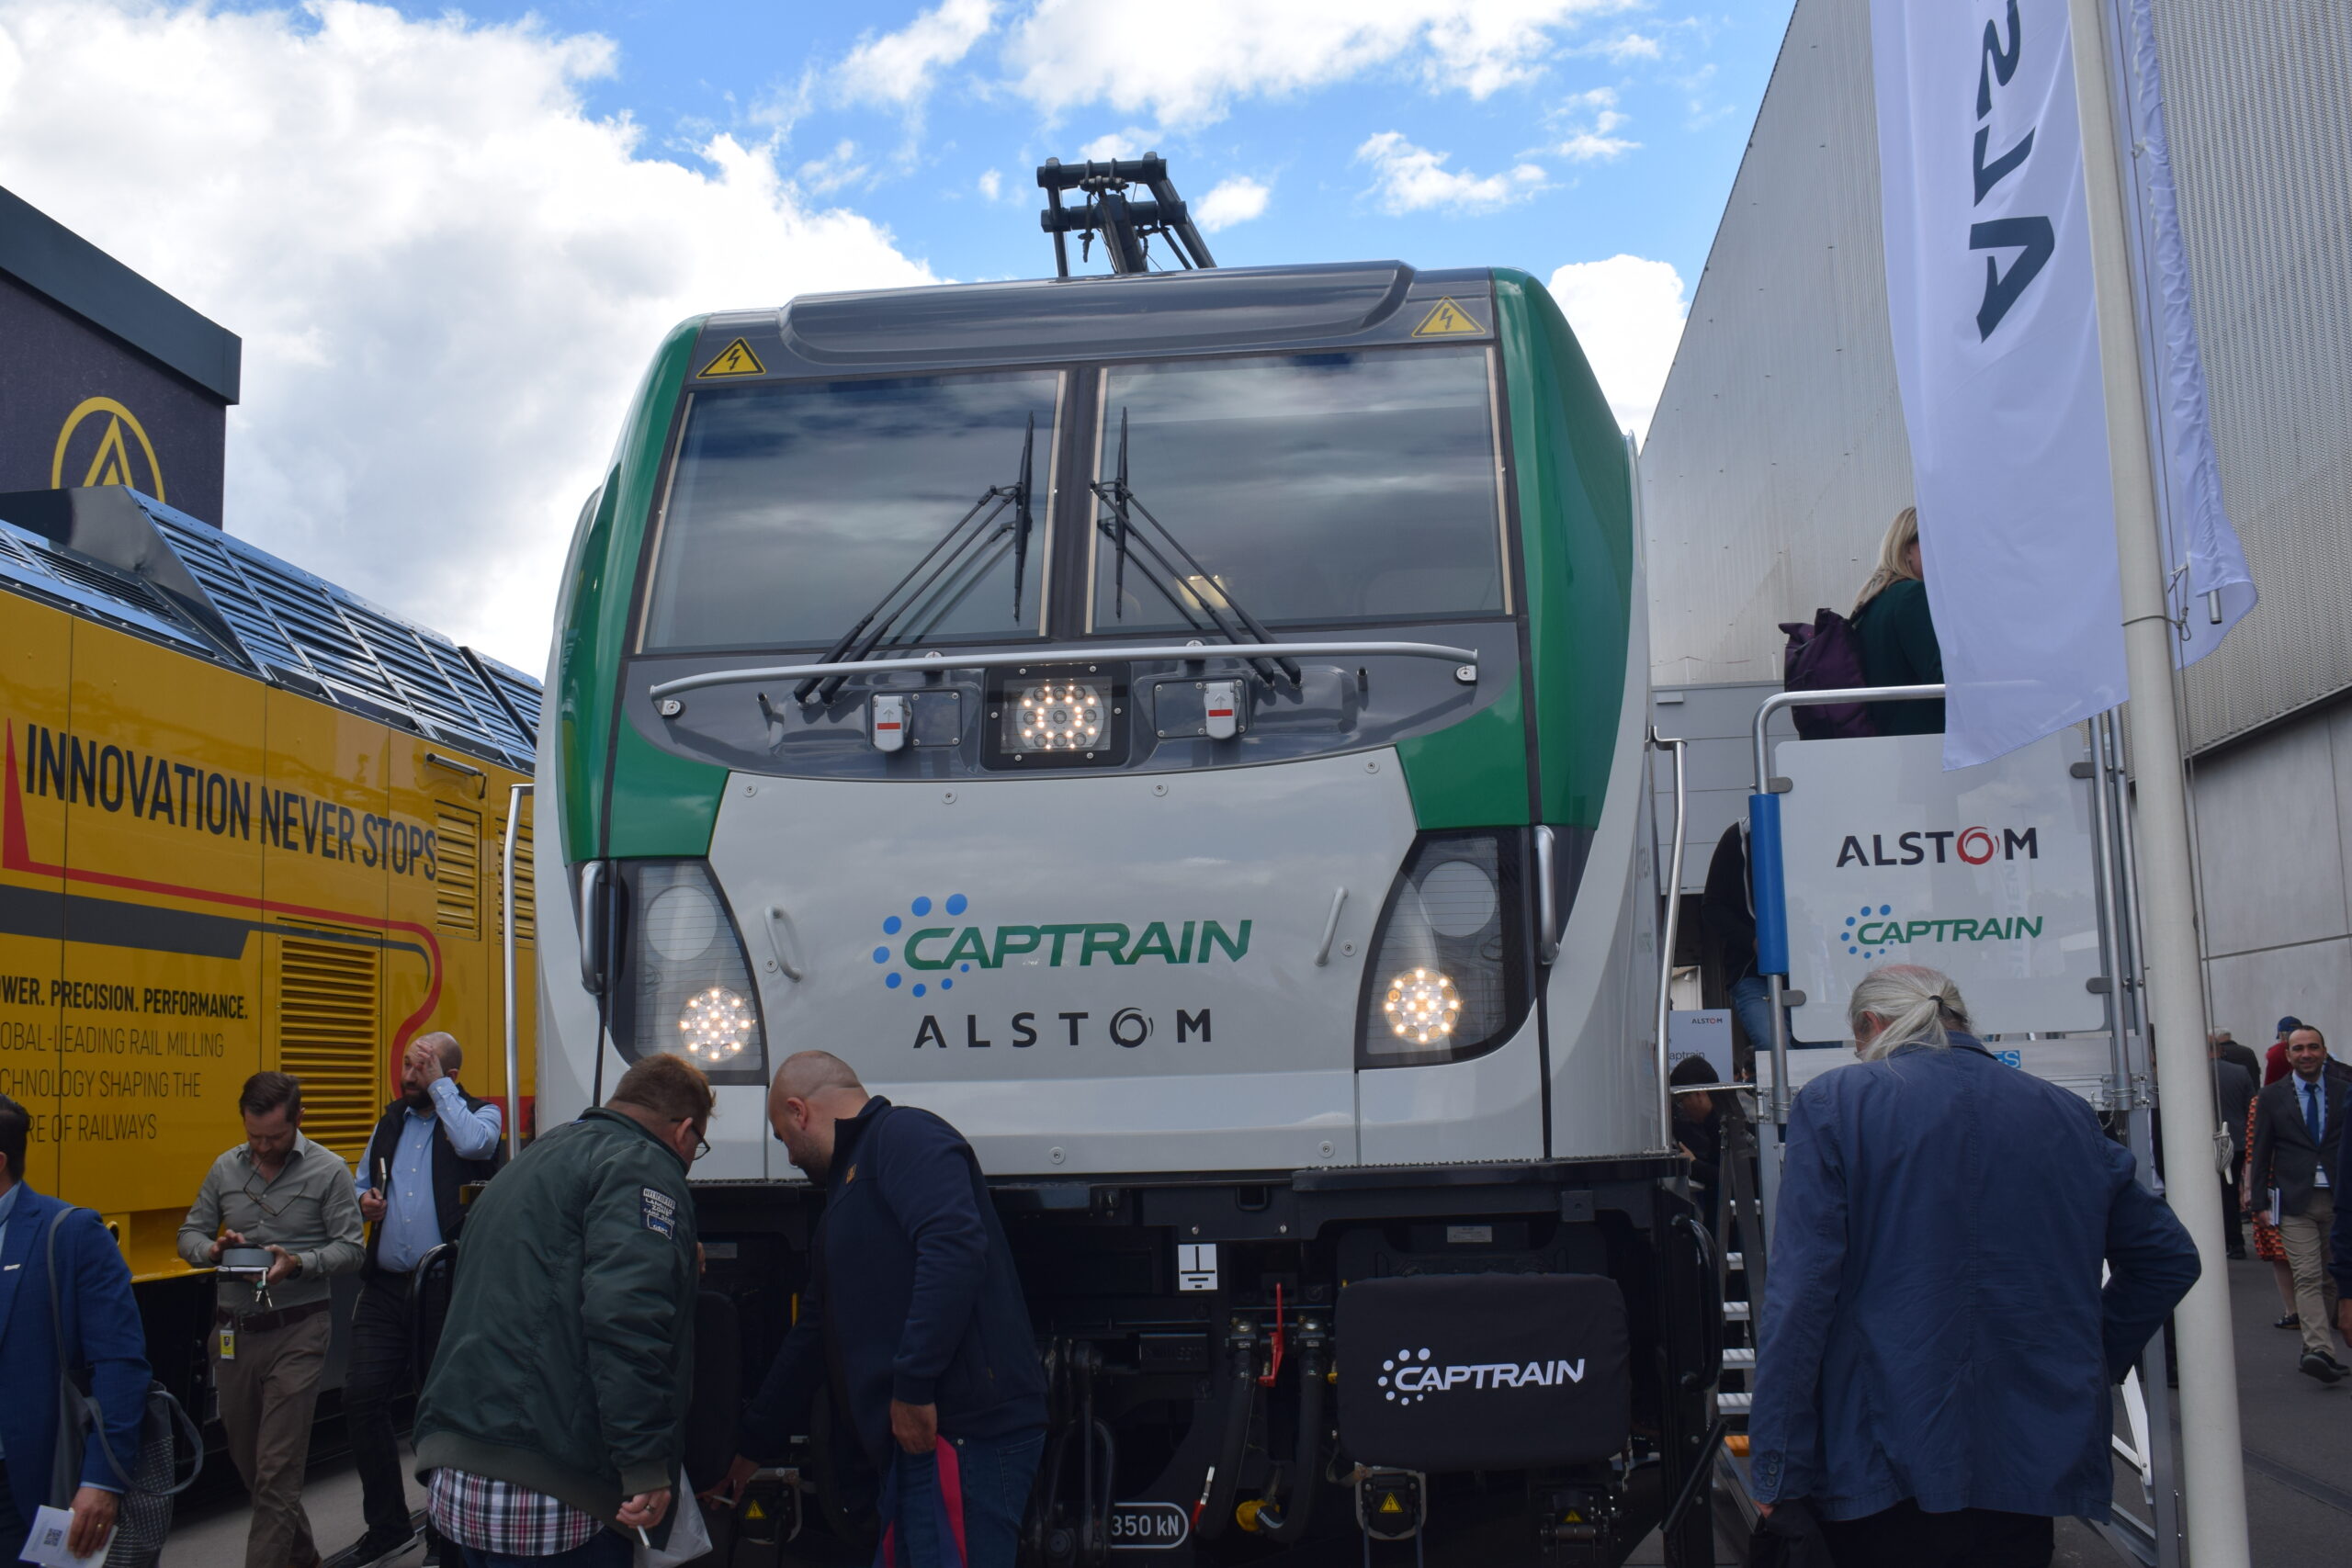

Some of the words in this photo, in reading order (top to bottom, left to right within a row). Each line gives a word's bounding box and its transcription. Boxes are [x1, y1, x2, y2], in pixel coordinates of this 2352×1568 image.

[26, 723, 251, 840] INNOVATION
[260, 785, 356, 863] NEVER
[361, 812, 437, 881] STOPS
[1836, 826, 2038, 868] ALSTOM
[903, 919, 1252, 971] CAPTRAIN
[1857, 916, 2043, 945] CAPTRAIN
[0, 976, 45, 1006] WER.
[51, 979, 139, 1013] PRECISION.
[143, 987, 248, 1021] PERFORMANCE.
[912, 1007, 1212, 1049] ALSTOM
[1691, 1017, 1724, 1025] ALSTOM
[130, 1028, 162, 1056] RAIL
[167, 1031, 224, 1058] MILLING
[99, 1069, 168, 1099] SHAPING
[173, 1072, 201, 1098] THE
[51, 1113, 74, 1143] OF
[78, 1112, 157, 1143] RAILWAYS
[1395, 1358, 1585, 1391] CAPTRAIN
[1111, 1515, 1151, 1537] 350
[1157, 1515, 1180, 1537] kN
